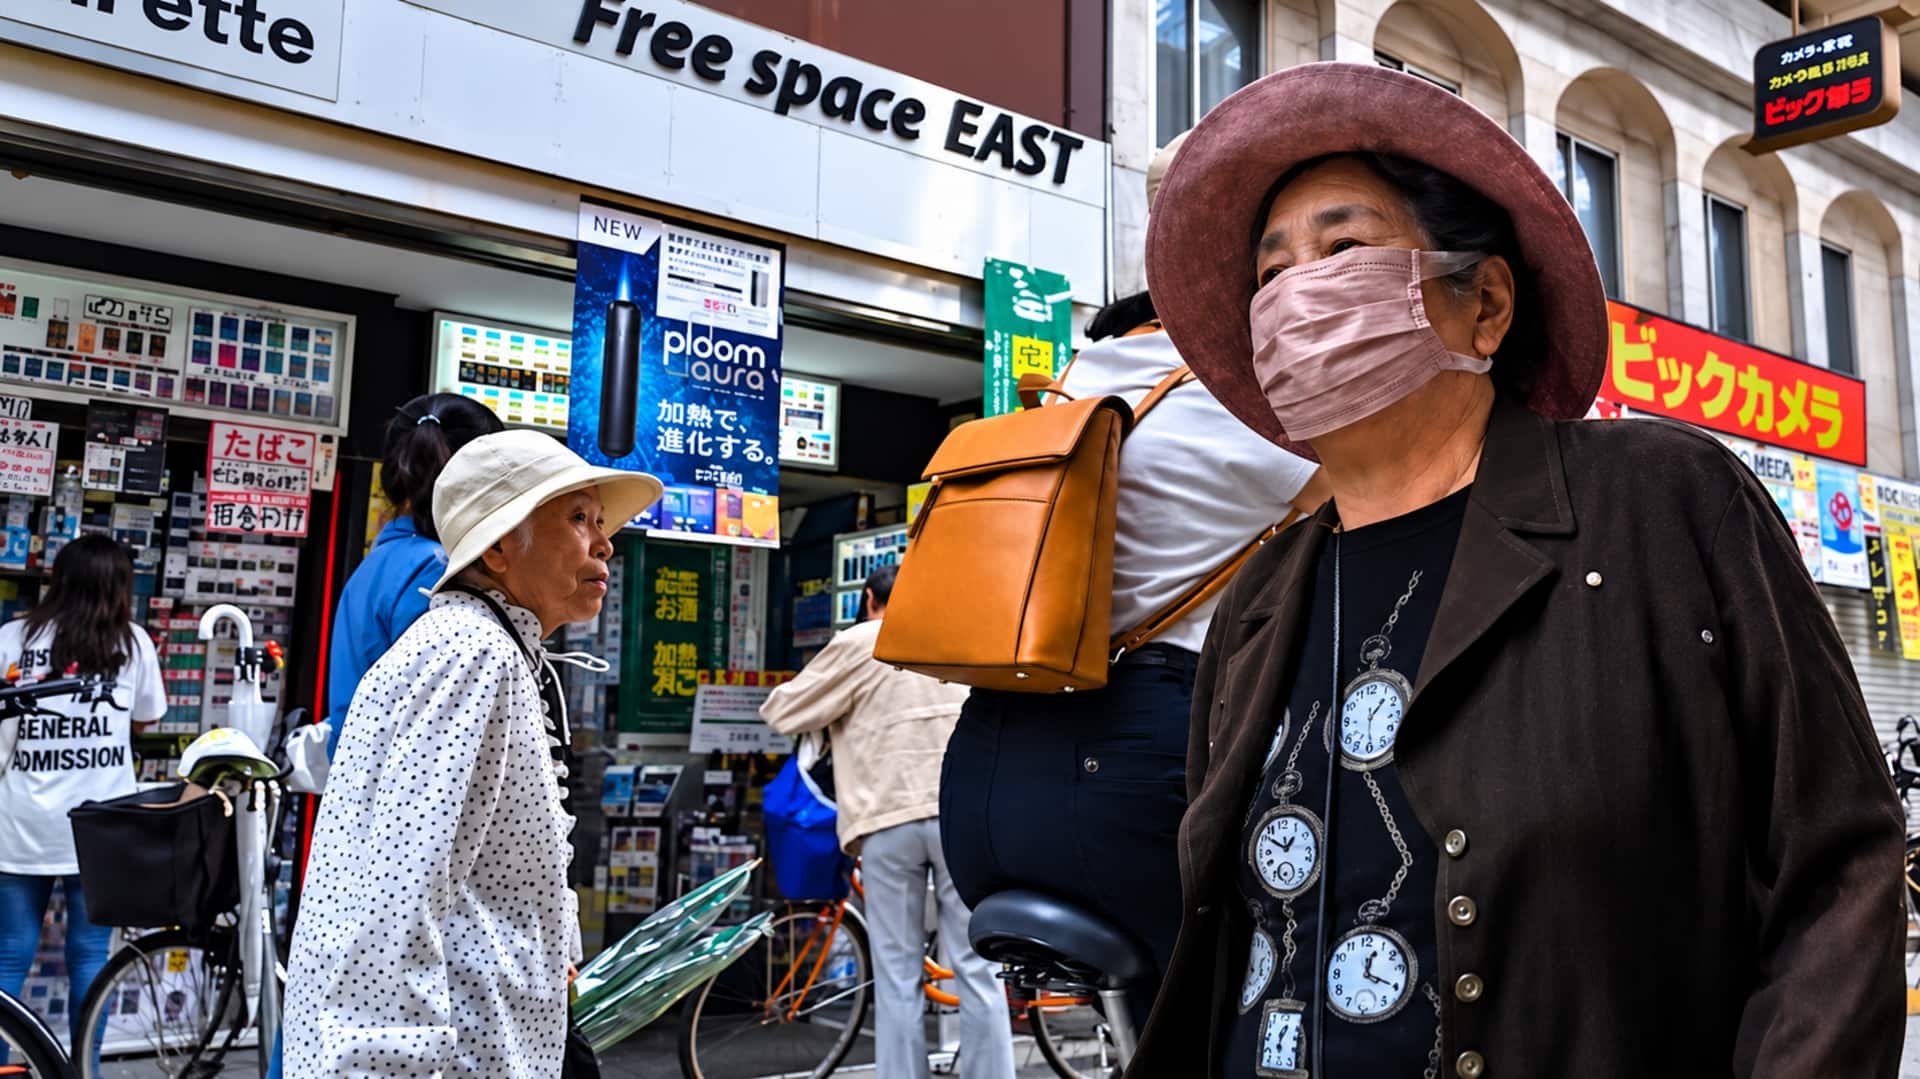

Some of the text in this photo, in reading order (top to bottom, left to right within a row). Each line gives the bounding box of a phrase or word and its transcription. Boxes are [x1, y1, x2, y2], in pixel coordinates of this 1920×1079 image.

[573, 0, 1084, 185] Free space EAST
[593, 215, 642, 241] NEW
[663, 326, 765, 368] ploom
[691, 361, 764, 391] aura
[1612, 320, 1844, 449] ビックカメラ
[657, 399, 746, 433] 加熱で、
[224, 429, 307, 464] たばこ
[656, 426, 773, 465] 進化する。
[12, 746, 125, 772] ADMISSION
[1361, 936, 1373, 947] 12
[1389, 950, 1397, 961] 2
